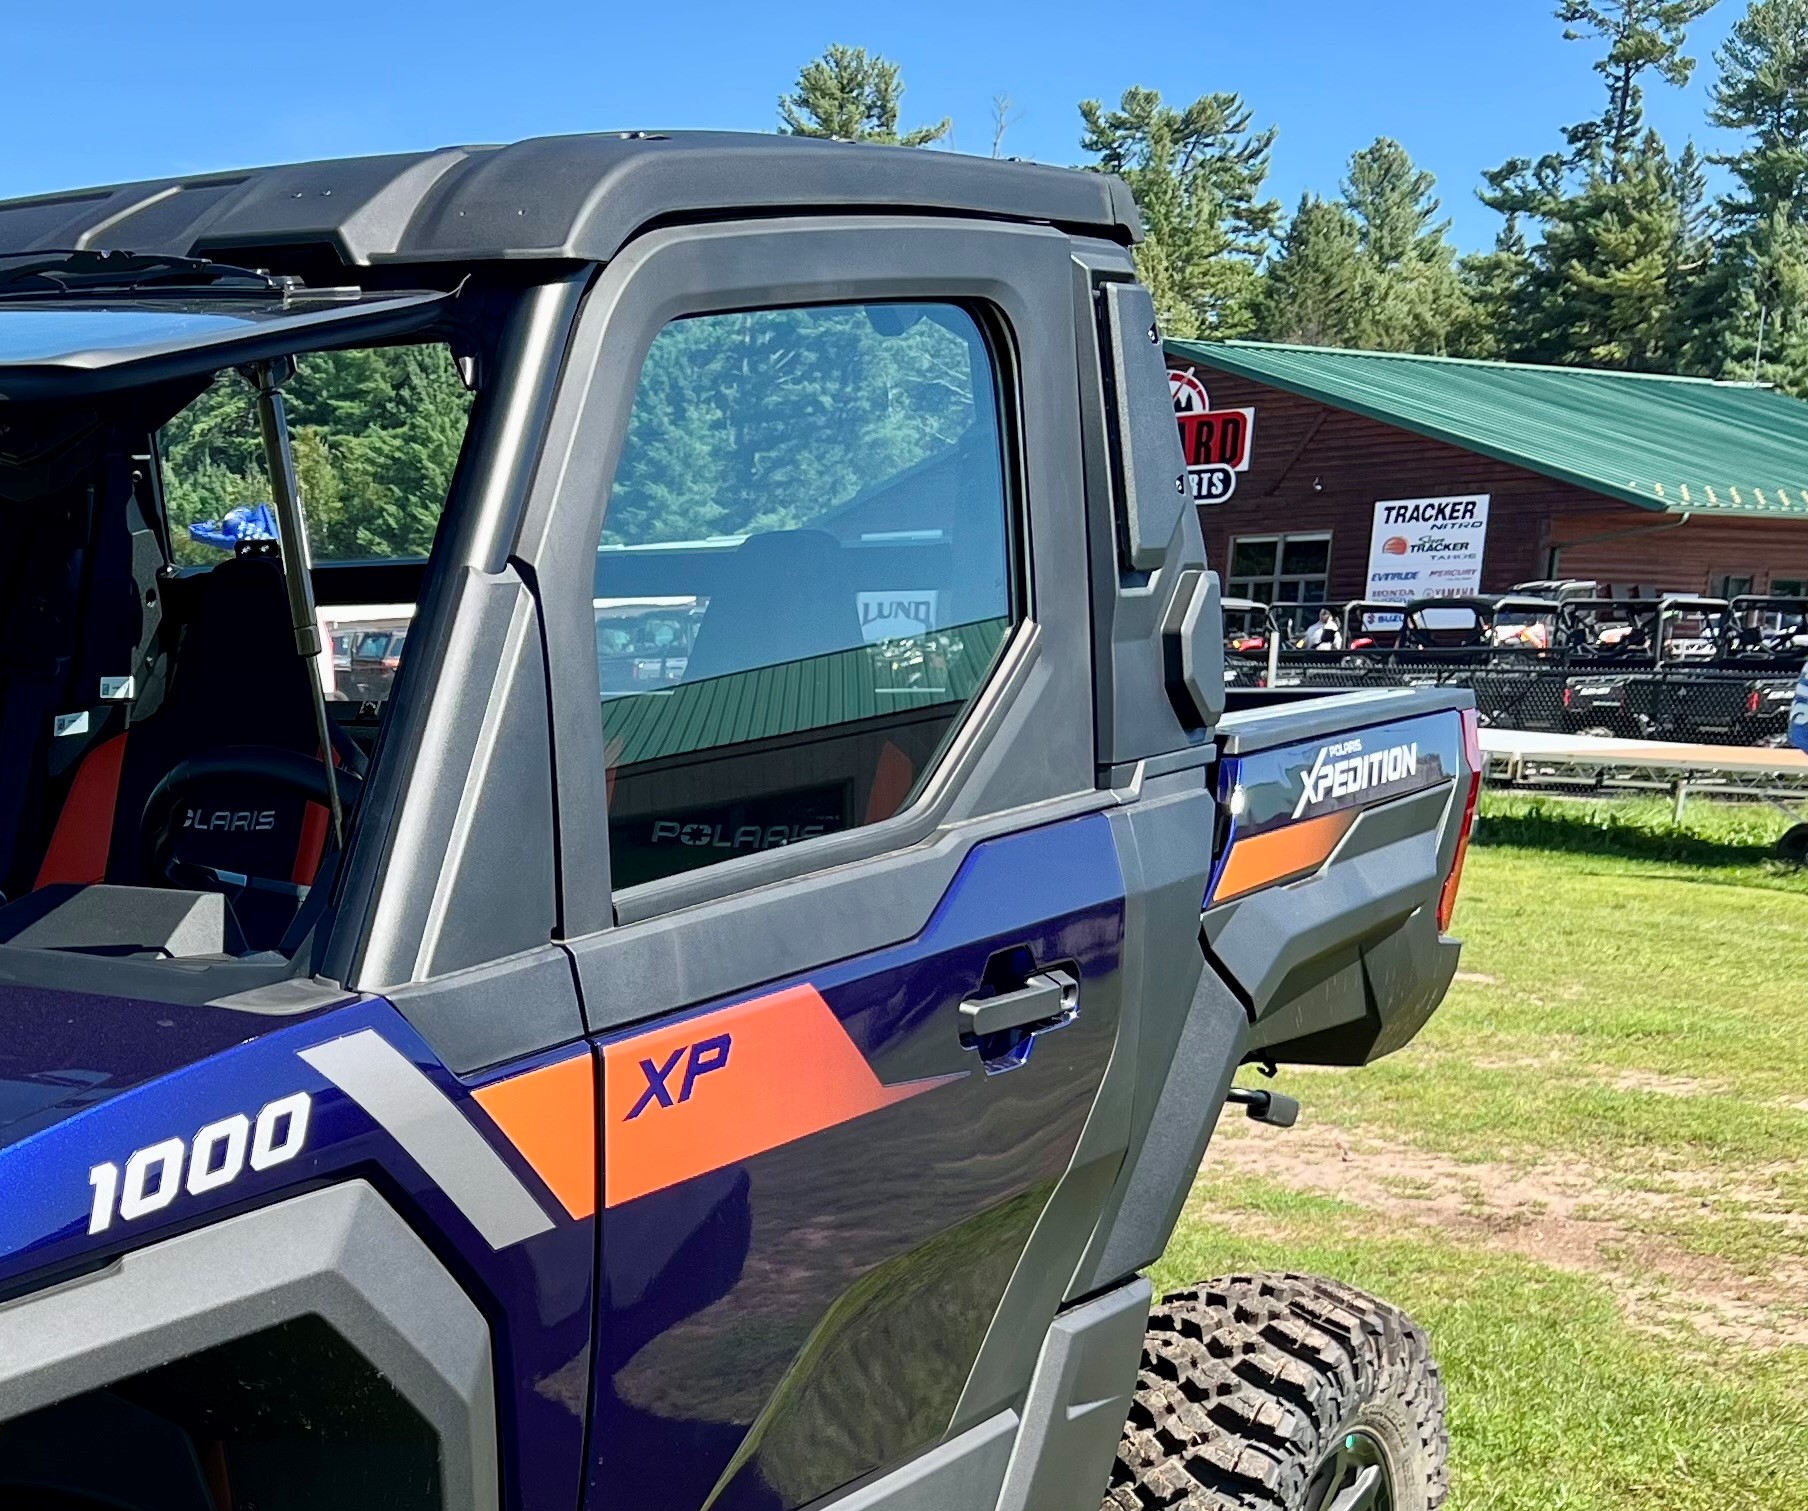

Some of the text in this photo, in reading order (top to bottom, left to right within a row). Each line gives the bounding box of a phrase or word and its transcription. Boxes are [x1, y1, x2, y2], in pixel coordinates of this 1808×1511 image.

[1189, 472, 1224, 496] RTS
[1384, 501, 1477, 524] TRACKER
[1430, 521, 1483, 531] NITRO
[1410, 542, 1469, 553] TRACKER
[862, 601, 930, 630] LUND
[1329, 739, 1362, 757] POLARIS
[1291, 742, 1417, 819] XPEDITION
[183, 809, 275, 831] LARIS
[622, 1033, 732, 1122] XP
[88, 1091, 311, 1235] 1000
